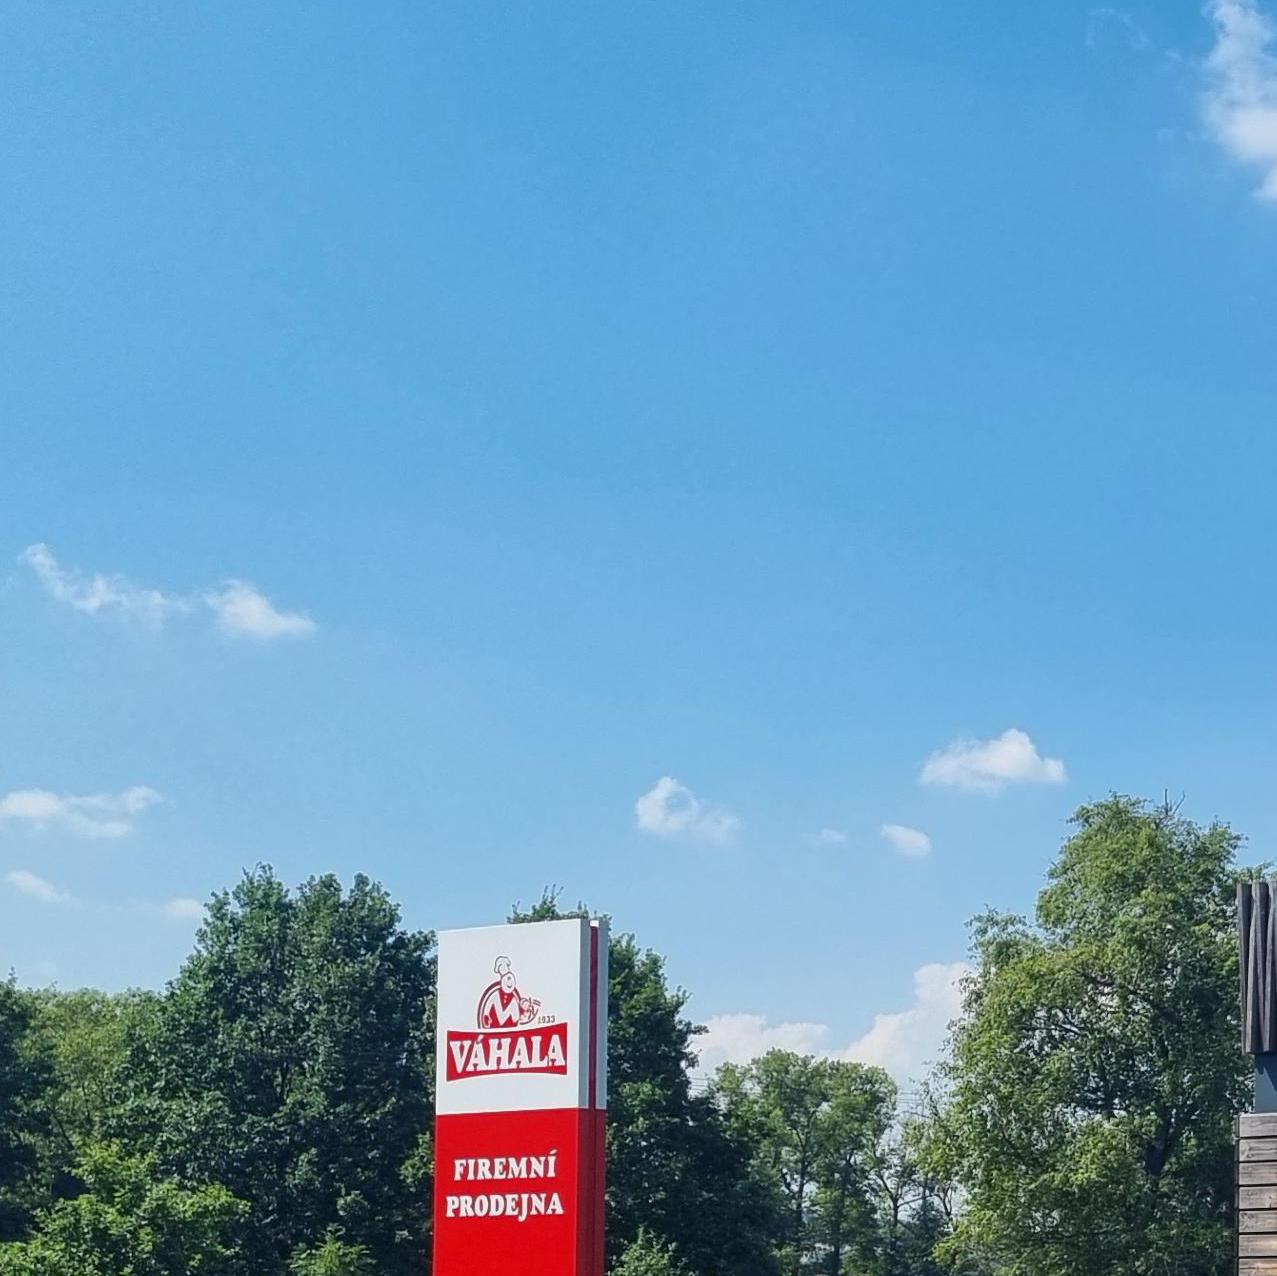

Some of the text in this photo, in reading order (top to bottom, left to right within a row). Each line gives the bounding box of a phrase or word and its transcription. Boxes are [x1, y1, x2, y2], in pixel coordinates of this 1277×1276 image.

[449, 1034, 566, 1073] VÁHALA
[454, 1149, 557, 1181] FIREMNÍ
[446, 1192, 564, 1222] PRODEJNA
